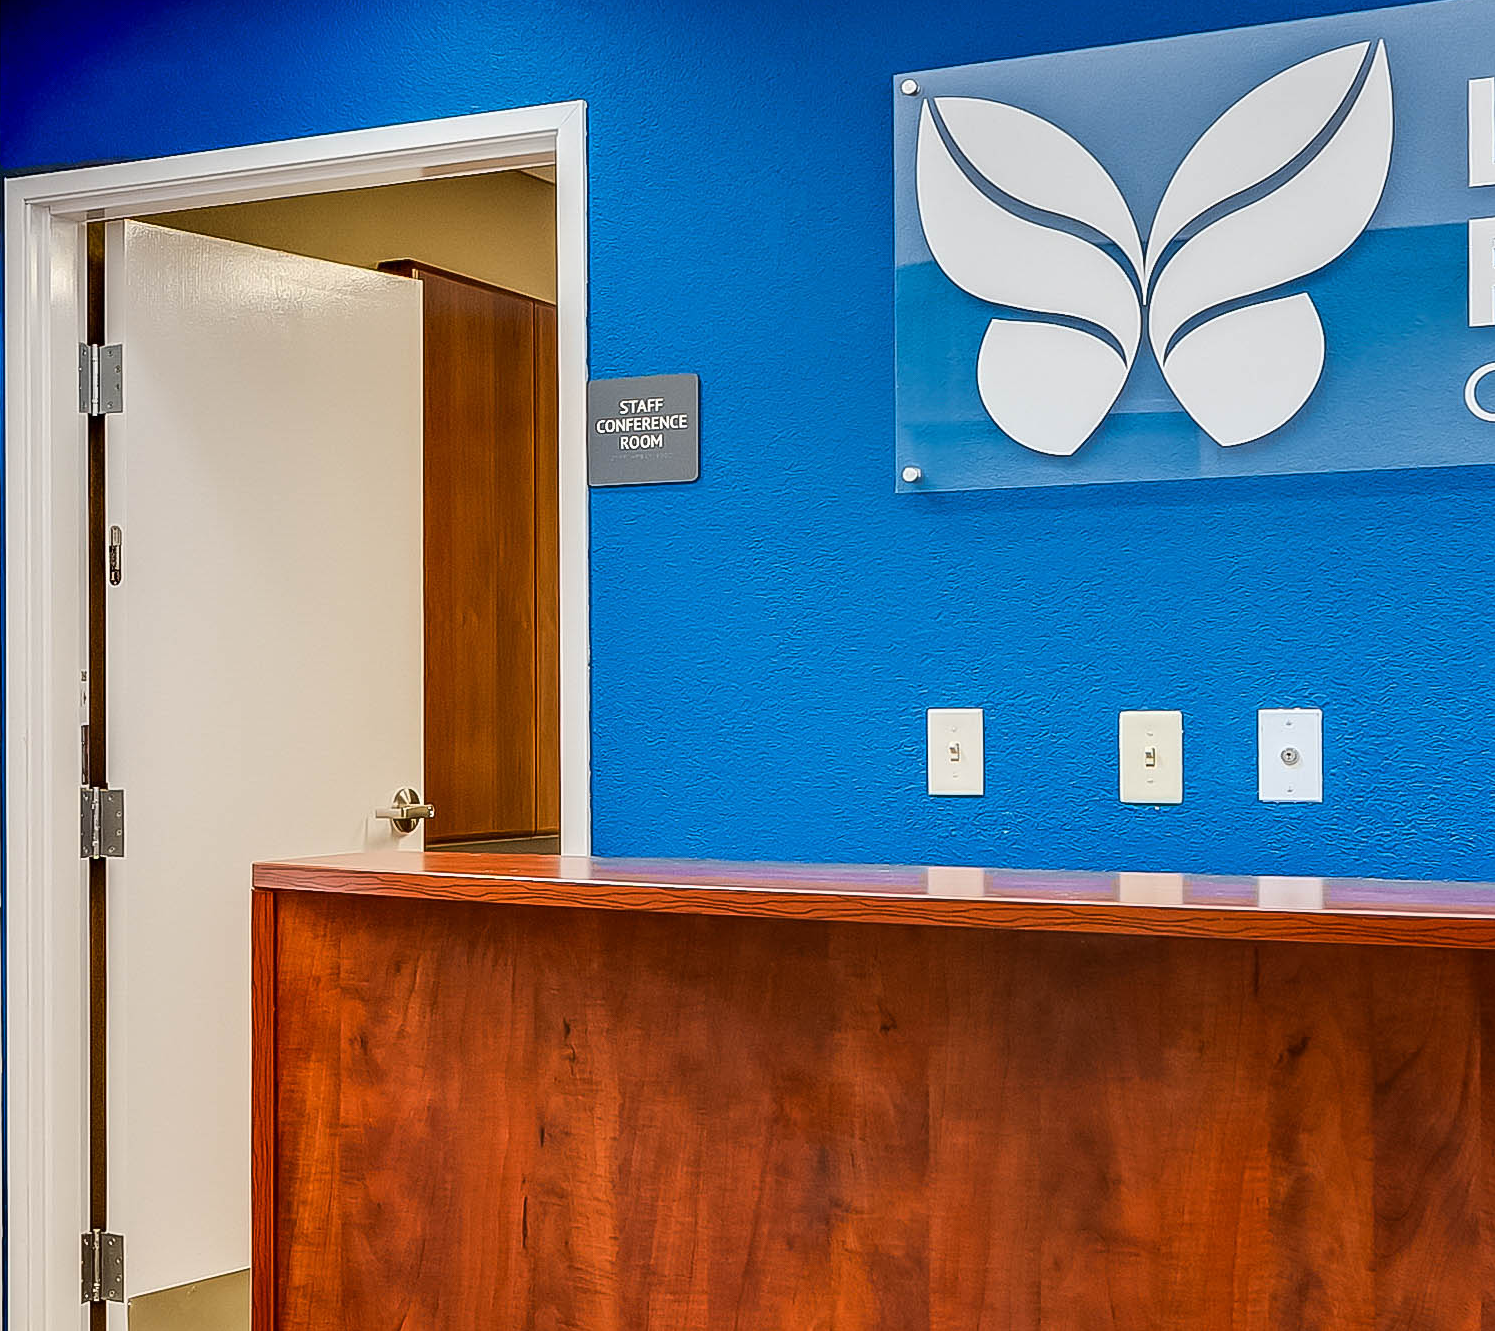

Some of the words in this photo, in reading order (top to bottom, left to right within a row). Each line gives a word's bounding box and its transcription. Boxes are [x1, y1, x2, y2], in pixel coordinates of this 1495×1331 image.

[619, 398, 664, 415] STAFF
[596, 415, 688, 434] CONFERENCE
[620, 434, 663, 450] ROOM
